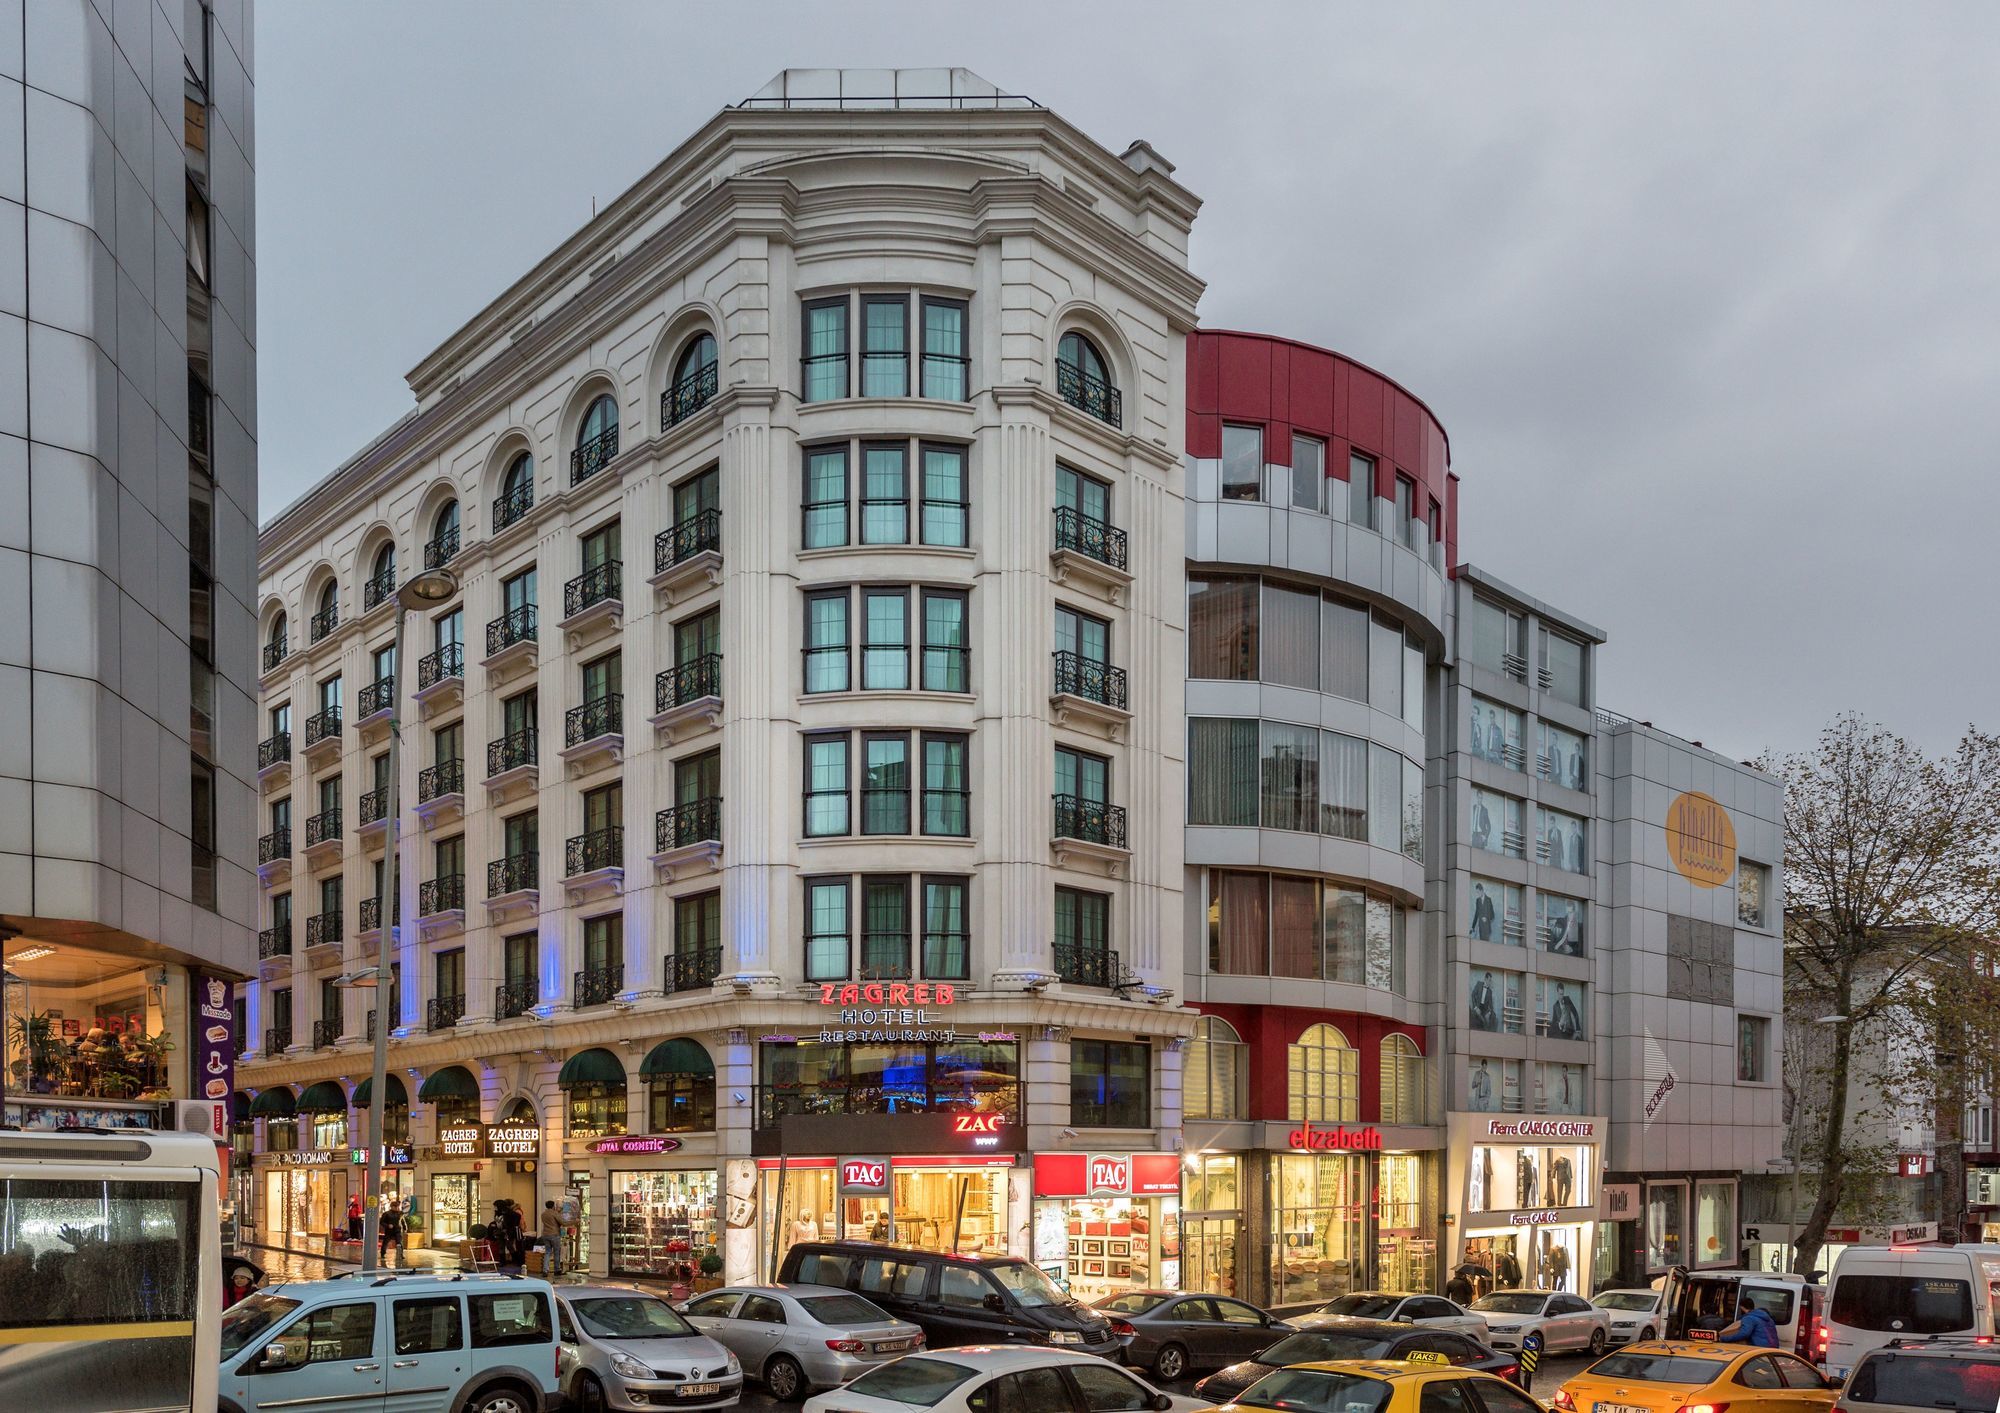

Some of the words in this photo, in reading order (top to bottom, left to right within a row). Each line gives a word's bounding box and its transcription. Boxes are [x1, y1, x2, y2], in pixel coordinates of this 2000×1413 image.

[820, 983, 955, 1005] ZAGREB
[841, 1008, 931, 1025] HOTEL
[819, 1030, 956, 1042] RESTAURANT
[441, 1129, 478, 1142] ZAGREB
[488, 1128, 539, 1141] ZAGREB
[1488, 1120, 1518, 1135] Pierre
[1518, 1120, 1558, 1136] CARLOS
[1558, 1121, 1594, 1136] CENTER
[1289, 1120, 1383, 1153] elizabeth
[444, 1142, 475, 1154] HOTEL
[493, 1141, 536, 1154] HOTEL
[845, 1165, 883, 1186] TAÇ
[1093, 1163, 1126, 1190] TAÇ
